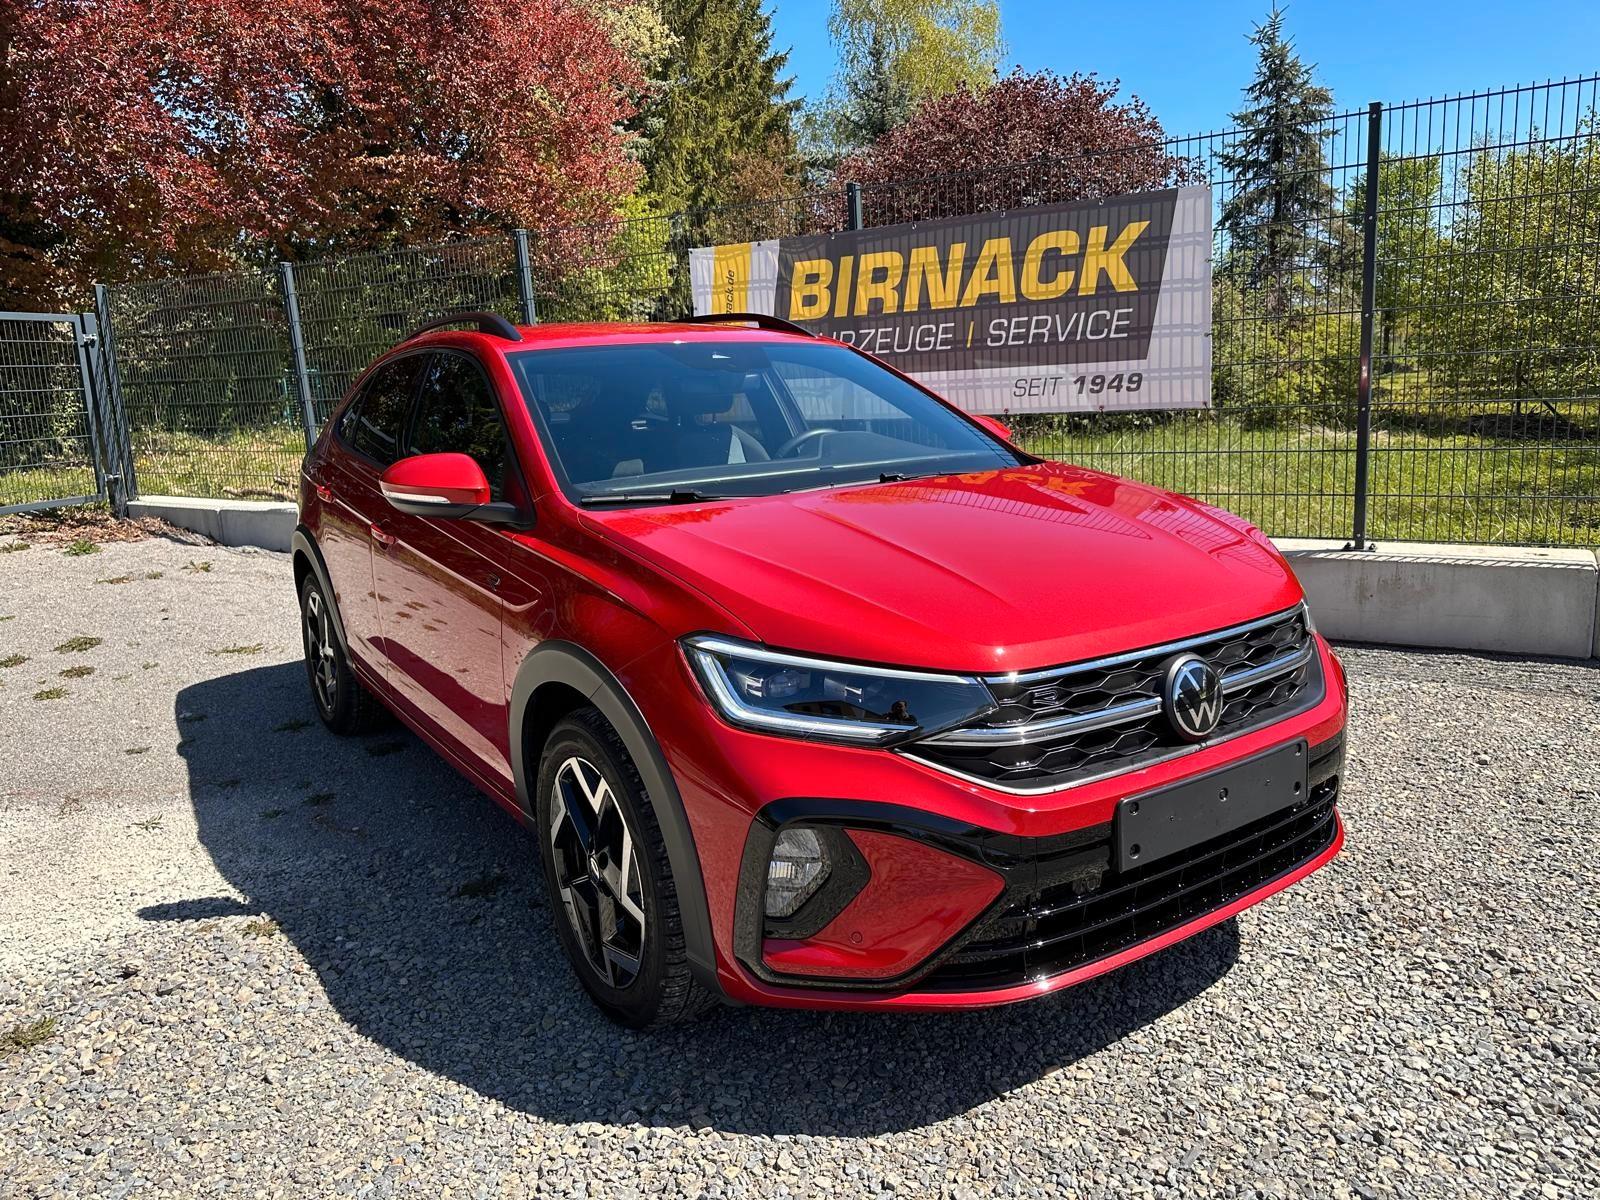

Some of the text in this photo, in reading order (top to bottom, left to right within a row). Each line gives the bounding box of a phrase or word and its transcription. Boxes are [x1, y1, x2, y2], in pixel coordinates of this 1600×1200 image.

[789, 220, 1151, 321] BIRNACK
[819, 307, 1134, 355] RZEUGE SERVICE
[1013, 372, 1143, 398] SEIT 1949
